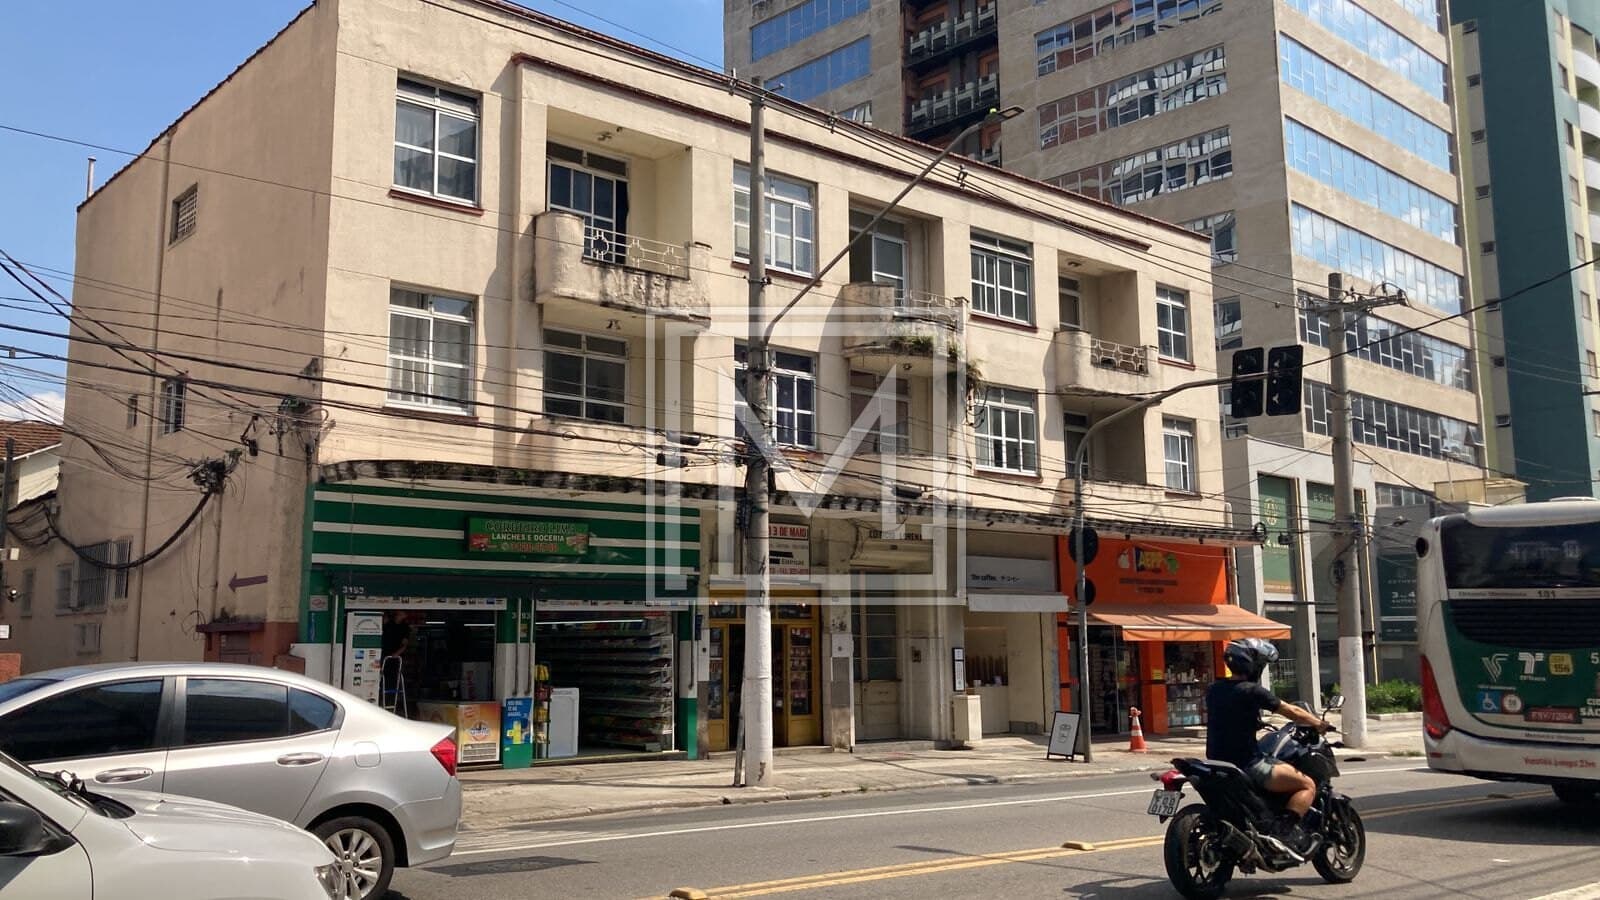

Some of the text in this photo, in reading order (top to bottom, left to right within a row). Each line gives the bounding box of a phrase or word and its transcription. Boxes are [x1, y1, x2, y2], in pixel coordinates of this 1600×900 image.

[491, 532, 565, 543] LANCHES E DOCERIA
